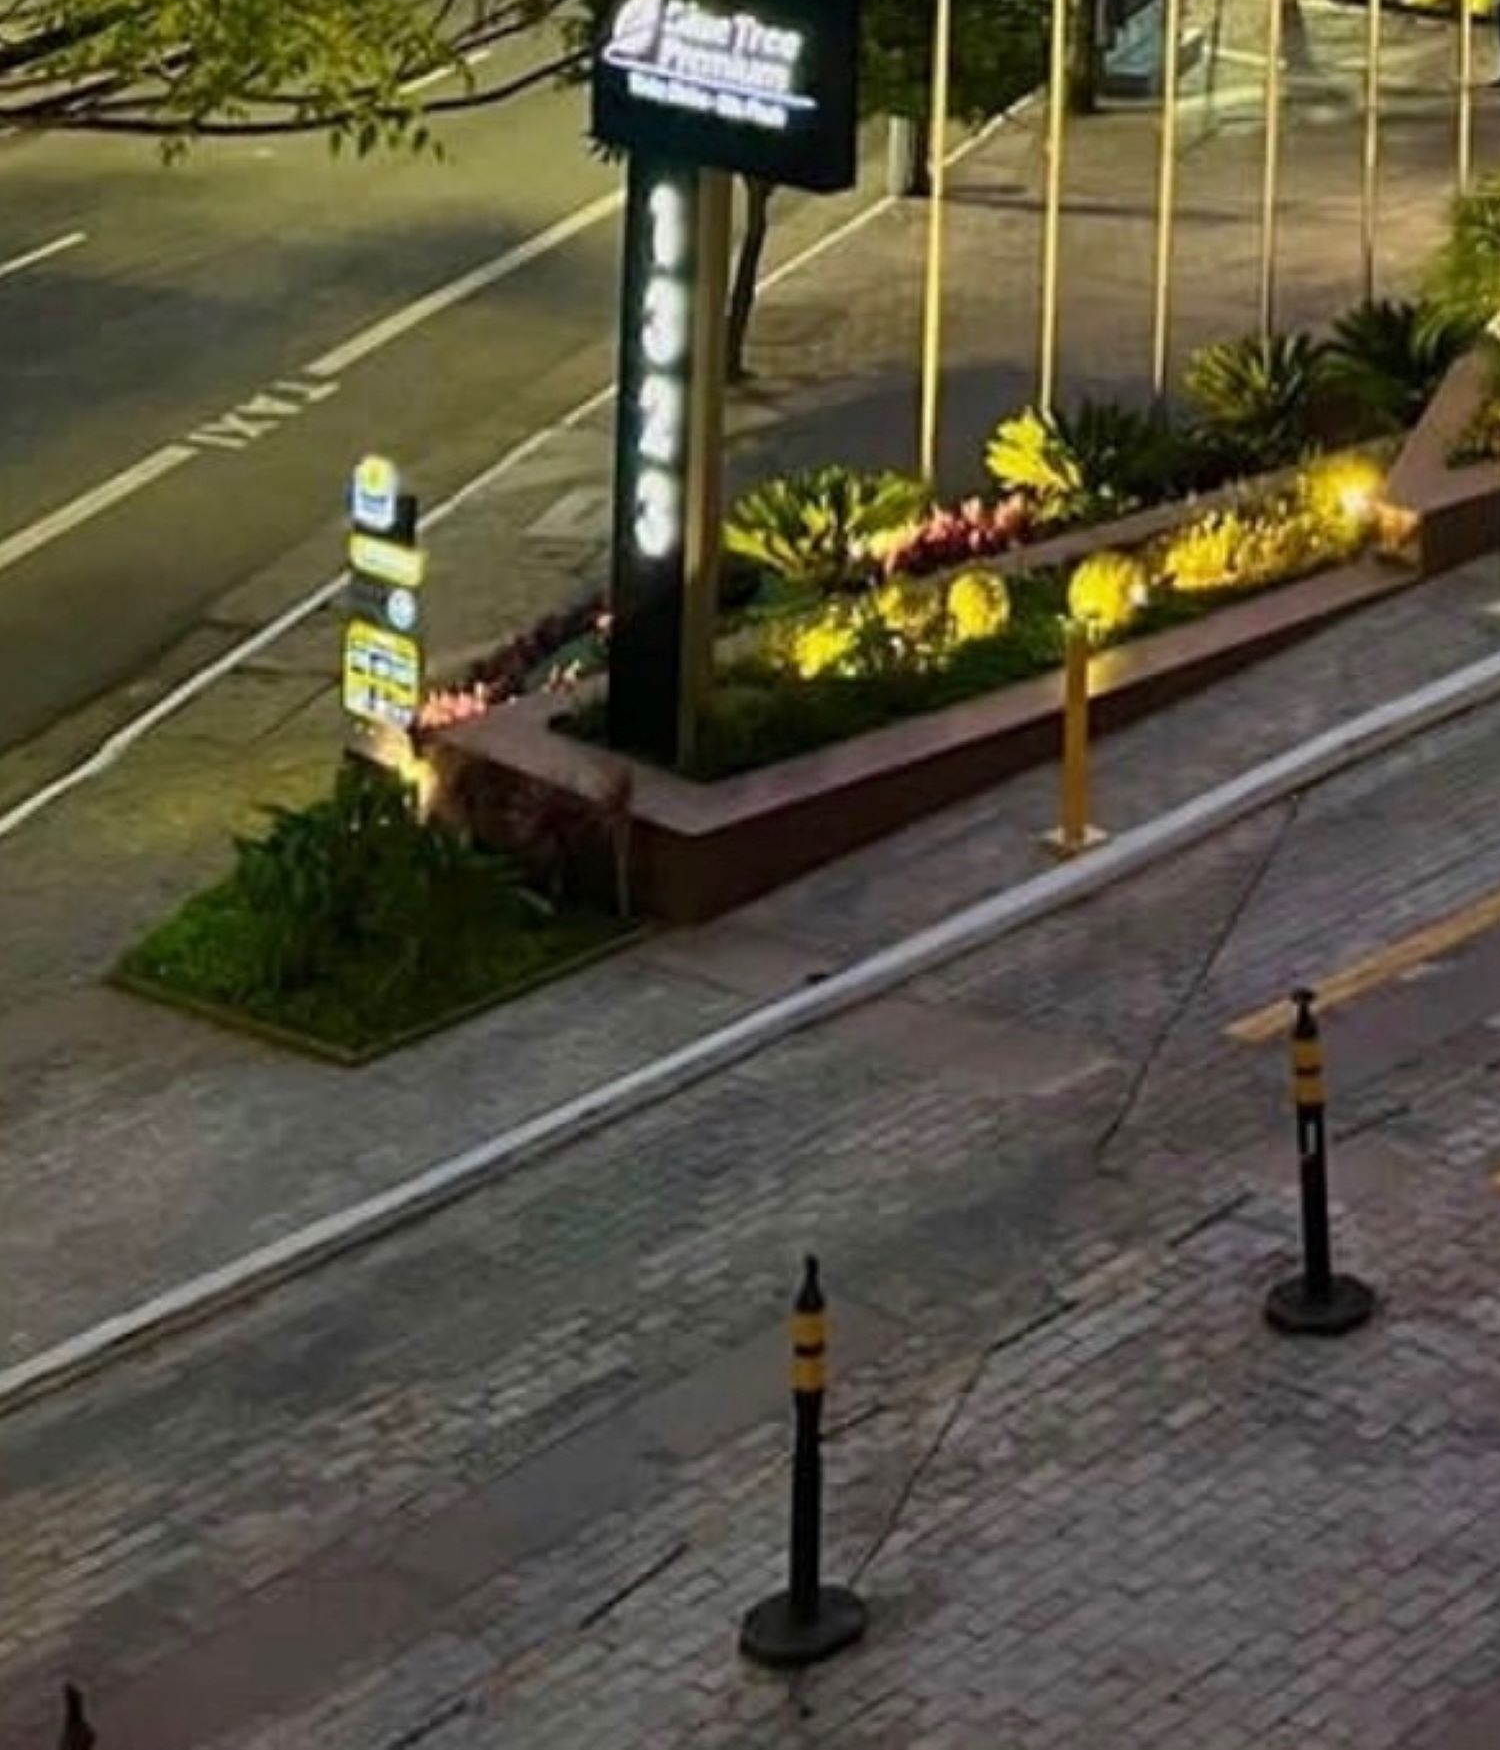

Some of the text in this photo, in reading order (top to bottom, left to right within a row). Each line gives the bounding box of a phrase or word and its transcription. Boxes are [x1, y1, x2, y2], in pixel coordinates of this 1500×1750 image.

[733, 13, 801, 59] Tree
[634, 183, 684, 556] 1323
[188, 378, 341, 448] TAXI
